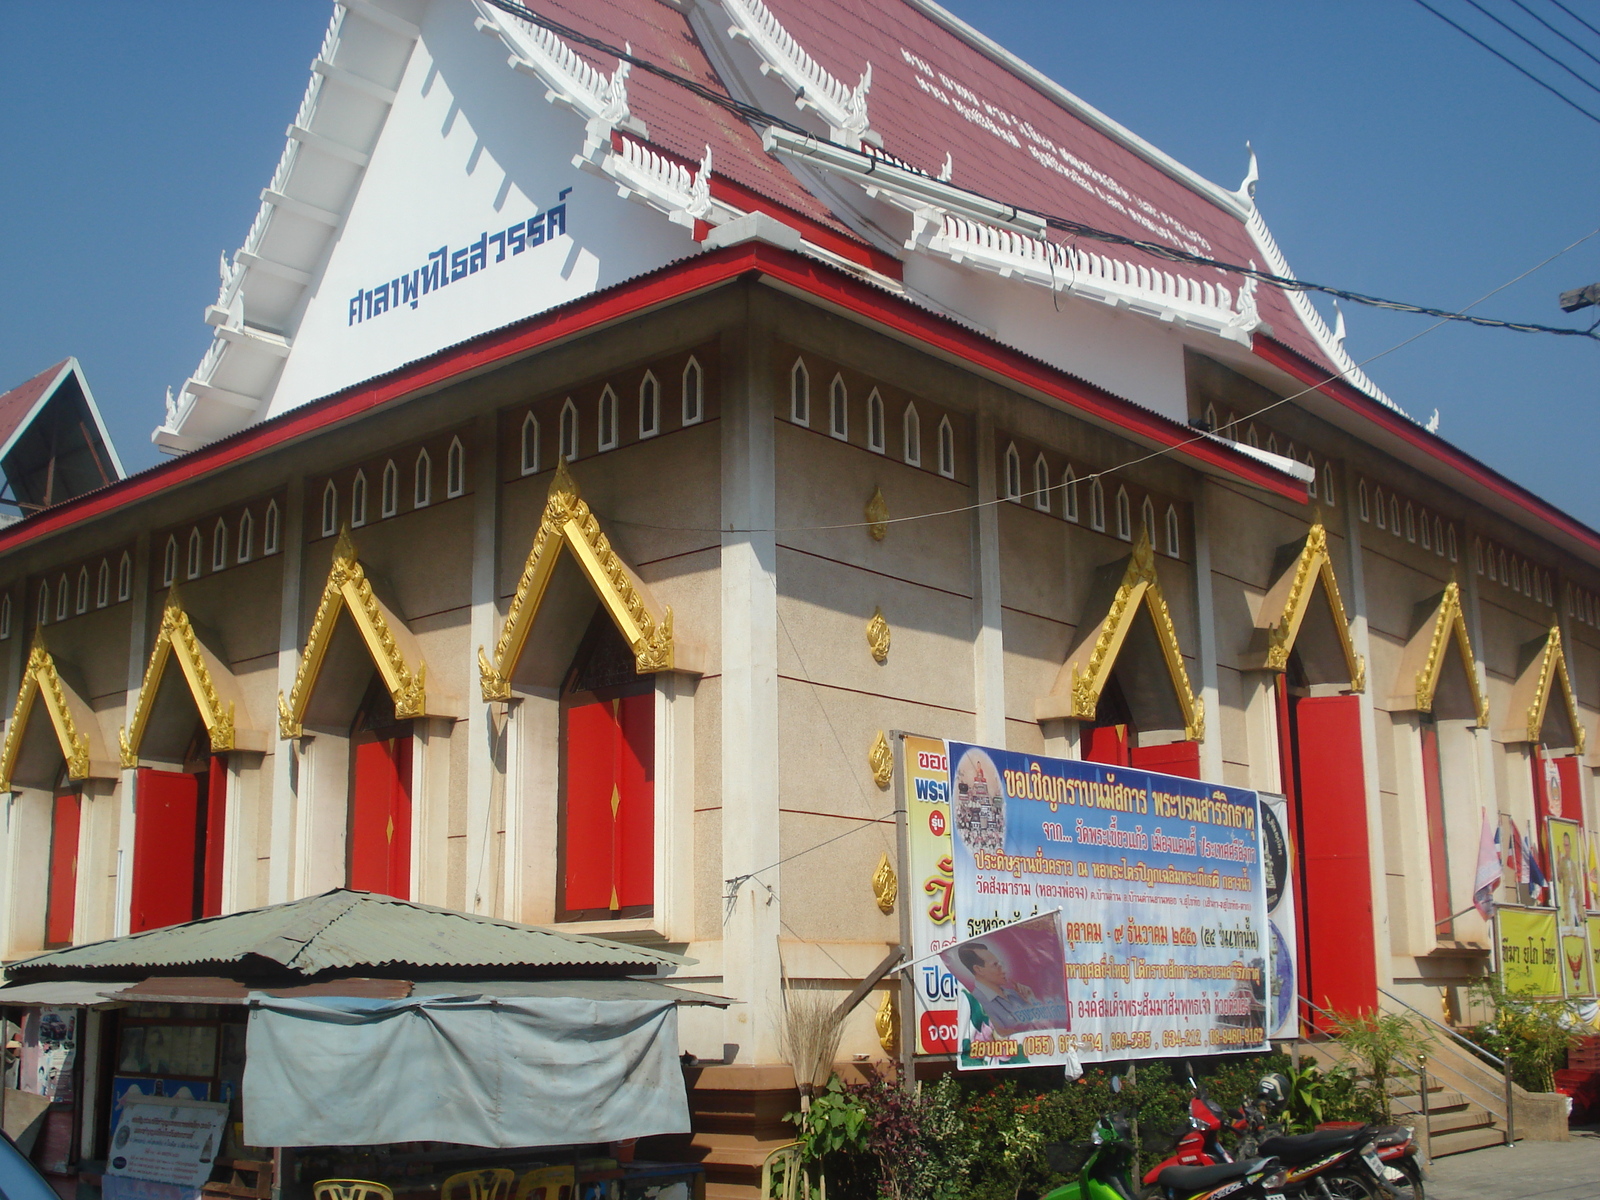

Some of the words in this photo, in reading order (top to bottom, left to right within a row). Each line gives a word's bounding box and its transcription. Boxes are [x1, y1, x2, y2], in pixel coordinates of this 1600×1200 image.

[1003, 762, 1148, 815] ขอเชิญกราบนมัสการ
[1152, 790, 1255, 840] พระบรมสารีริกธาตุ
[931, 815, 944, 831] รุ่น
[1077, 862, 1089, 877] ณ
[1066, 921, 1102, 951] ตุลาคม
[1127, 916, 1169, 946] ธันวาคม
[970, 1039, 1018, 1058] สอบถาม
[1023, 1036, 1055, 1057] (055)
